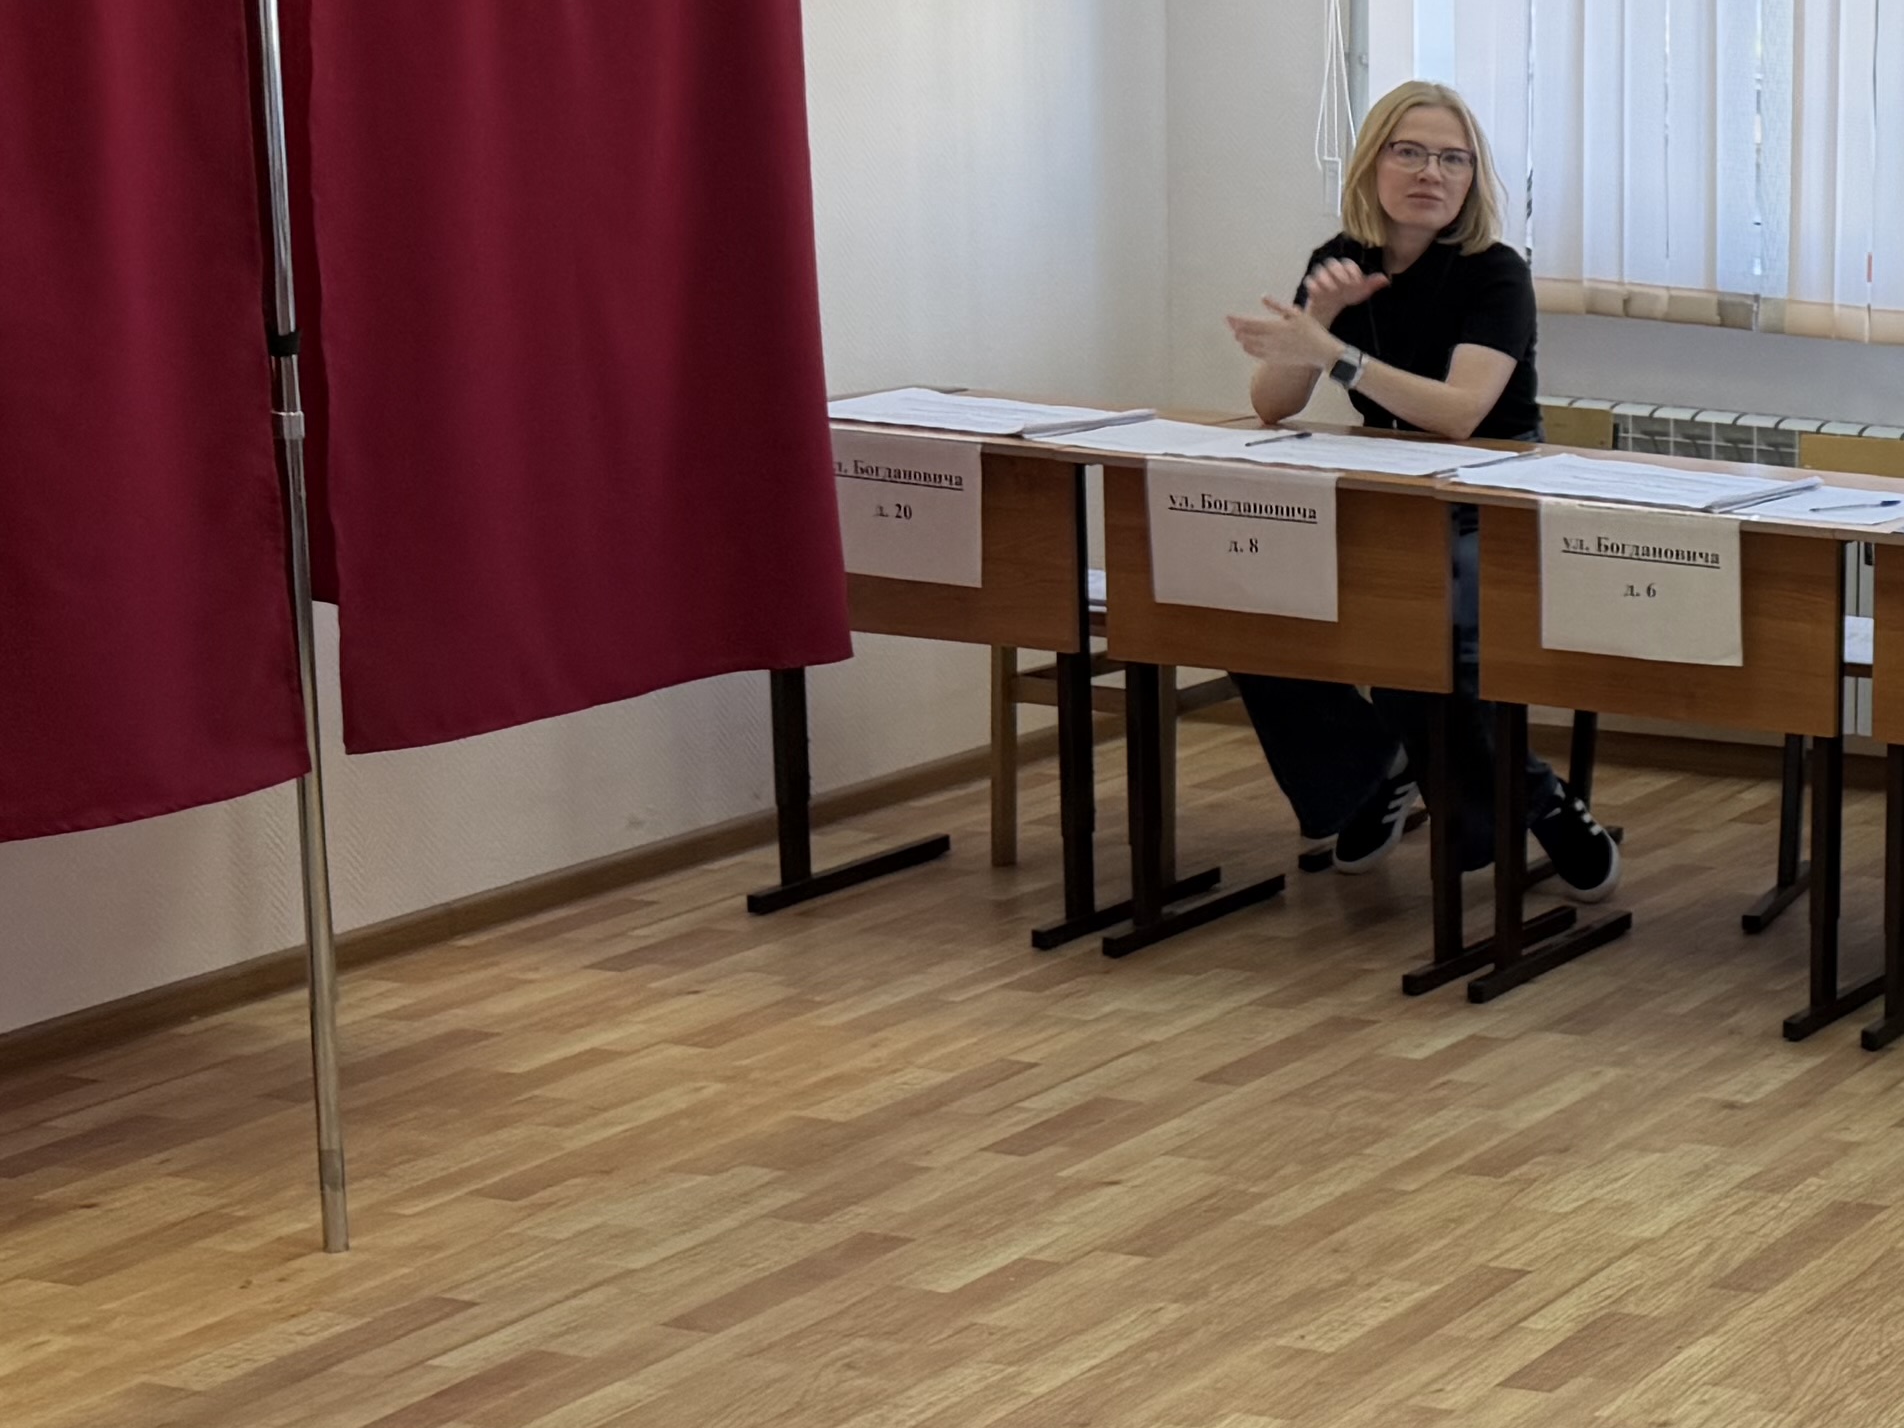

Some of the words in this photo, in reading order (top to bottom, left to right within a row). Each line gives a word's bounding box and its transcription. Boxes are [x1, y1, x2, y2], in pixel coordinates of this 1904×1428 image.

[854, 460, 963, 486] Богдановича
[895, 503, 912, 520] 20
[1169, 494, 1195, 509] ул.
[1201, 493, 1317, 519] Богдановича
[1249, 538, 1259, 553] 8
[1563, 537, 1590, 551] ул.
[1597, 536, 1720, 564] Богдановича
[1623, 583, 1641, 597] д.
[1646, 582, 1657, 598] 6
